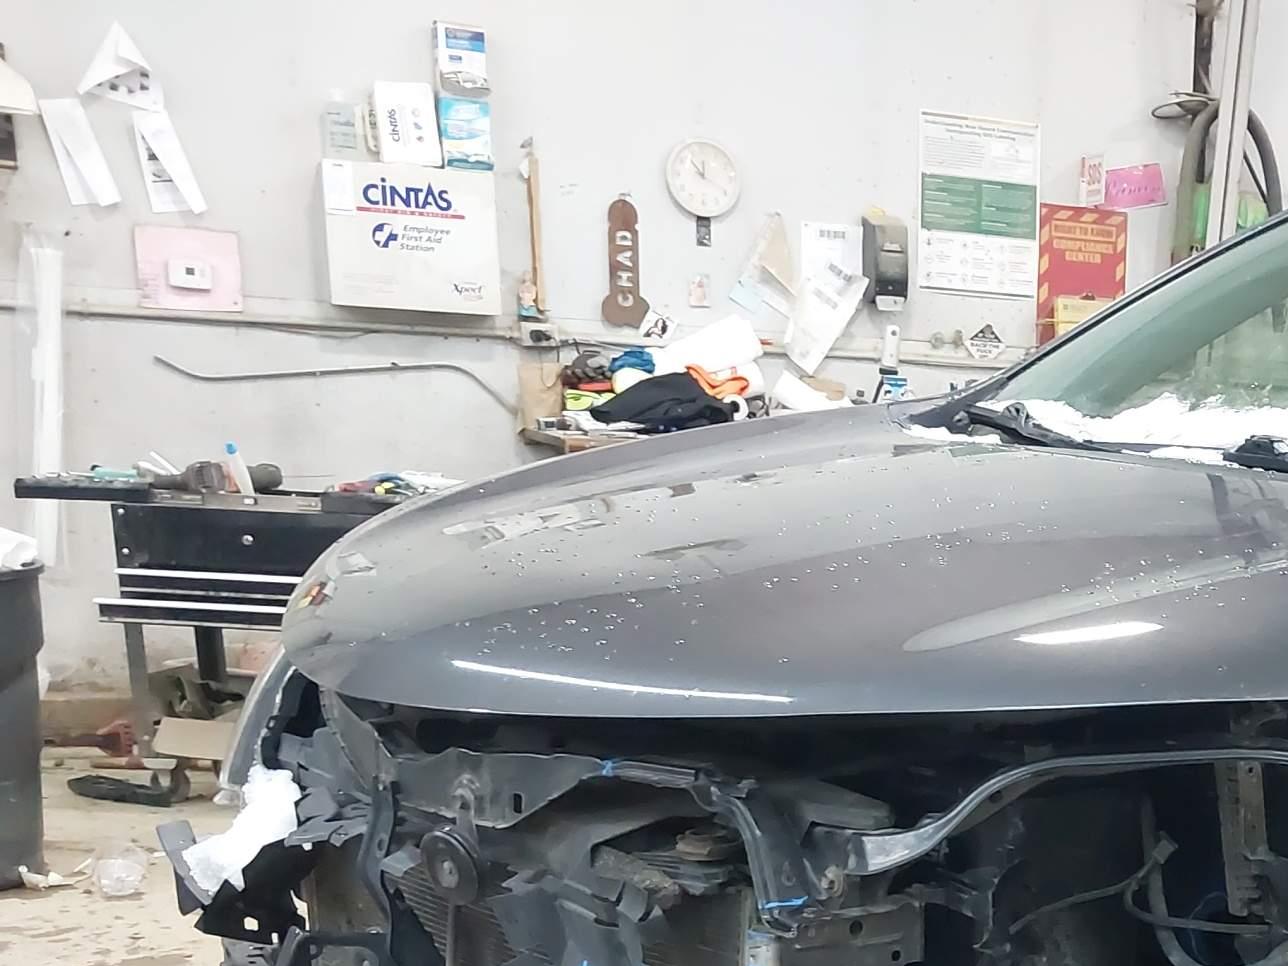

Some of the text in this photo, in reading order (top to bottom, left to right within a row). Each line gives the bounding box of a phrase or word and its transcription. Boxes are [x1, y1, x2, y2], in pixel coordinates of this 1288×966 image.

[403, 225, 451, 236] Employee
[401, 234, 443, 244] First Aid
[400, 243, 435, 252] Station
[615, 230, 634, 307] CHAD
